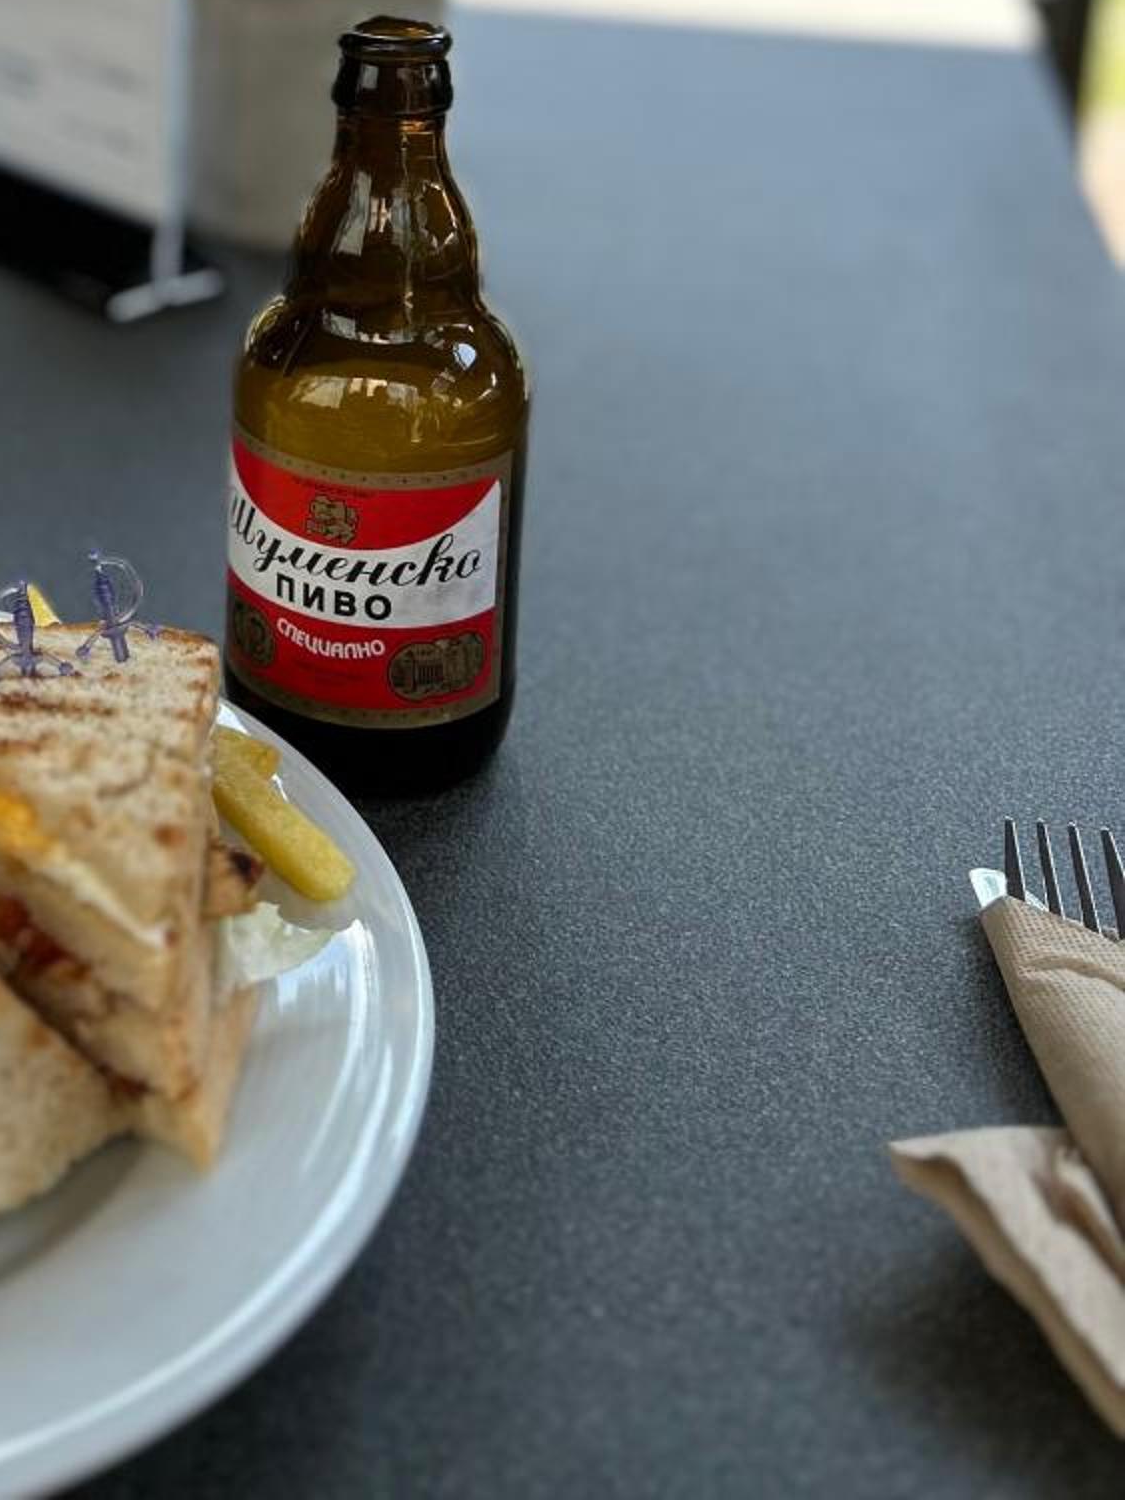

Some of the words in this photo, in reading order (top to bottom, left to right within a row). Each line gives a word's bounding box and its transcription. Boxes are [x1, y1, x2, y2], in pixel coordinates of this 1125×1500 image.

[230, 494, 481, 587] Шуменско
[276, 573, 392, 620] ПИВО
[277, 617, 385, 659] СПЕЦИАЛНО
